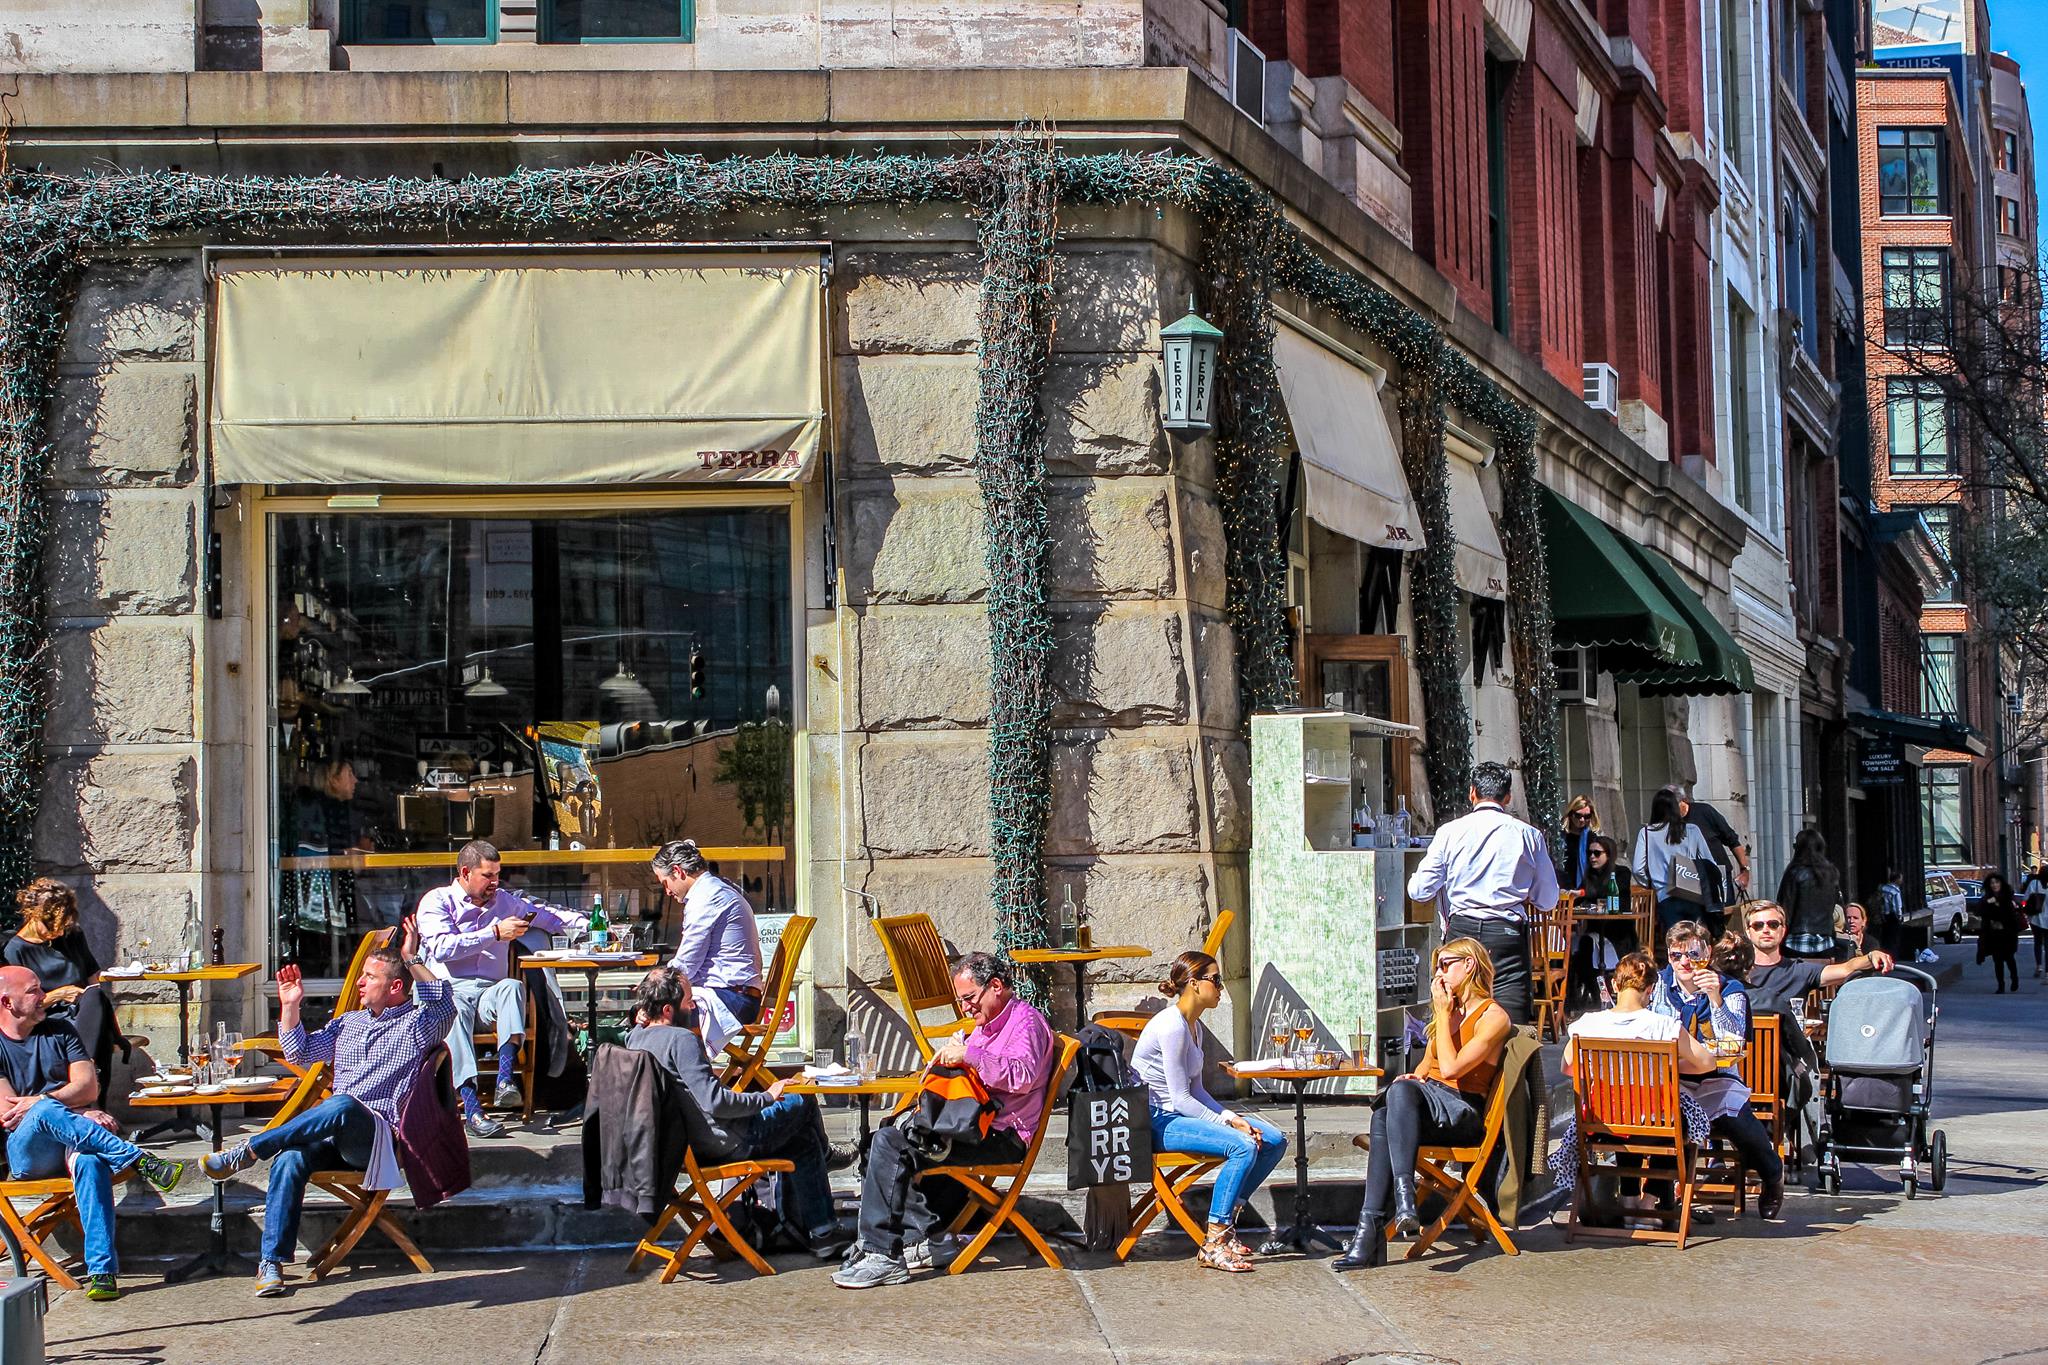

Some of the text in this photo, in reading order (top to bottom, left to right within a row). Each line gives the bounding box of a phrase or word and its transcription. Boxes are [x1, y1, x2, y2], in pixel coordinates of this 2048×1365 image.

[1174, 348, 1182, 412] TERRA
[1195, 348, 1206, 412] TERRA
[696, 449, 802, 470] TERRA
